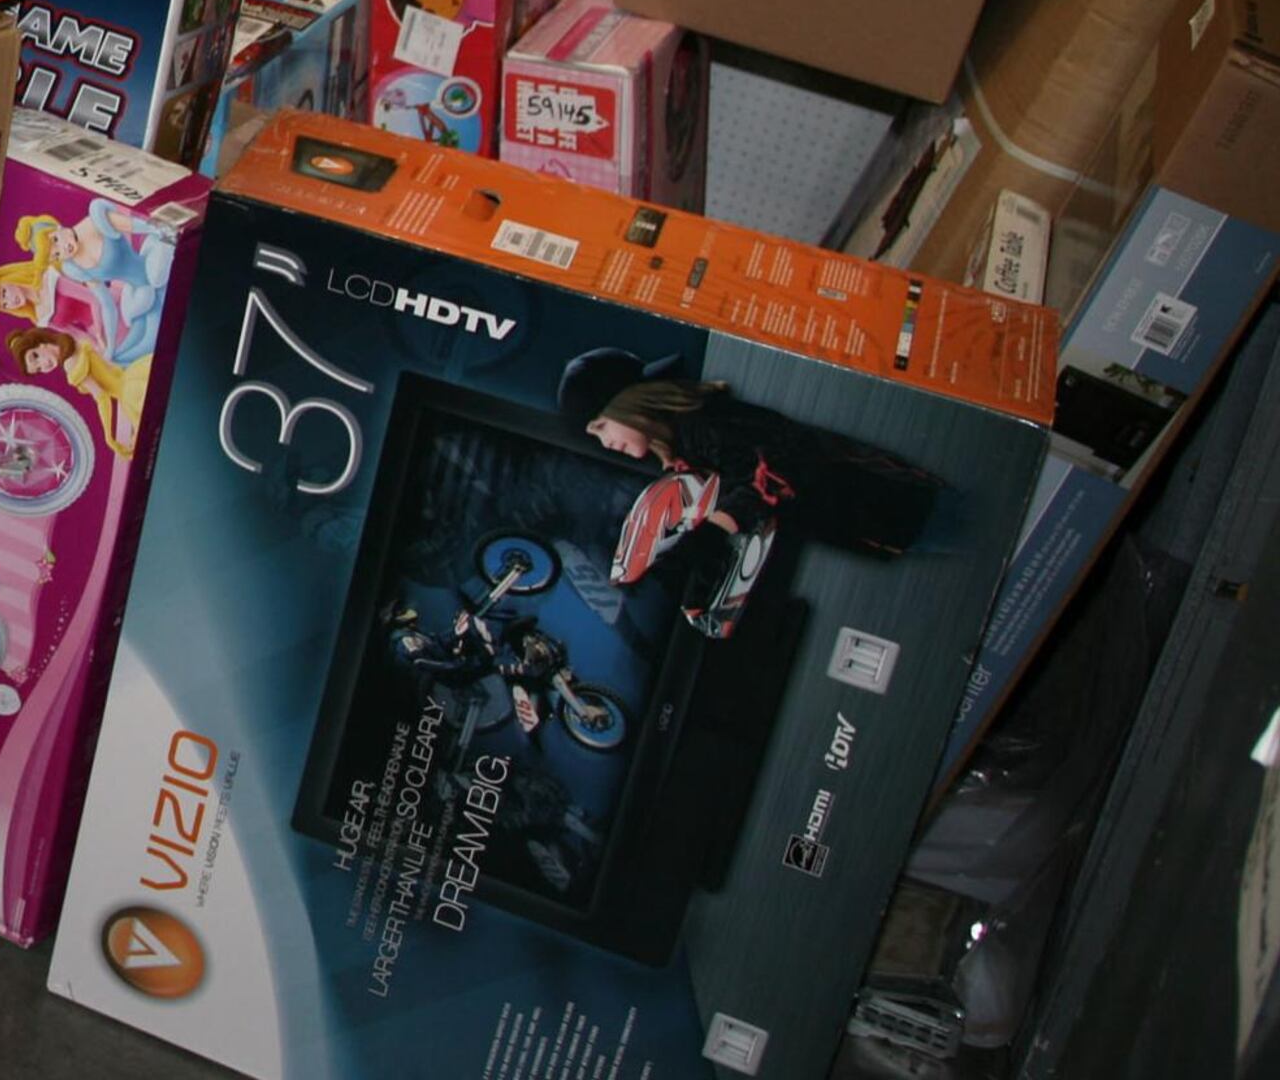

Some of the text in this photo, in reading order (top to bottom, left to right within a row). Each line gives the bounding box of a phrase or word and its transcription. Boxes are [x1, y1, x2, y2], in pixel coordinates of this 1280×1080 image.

[16, 2, 136, 77] AME
[526, 93, 593, 126] 59145
[404, 694, 447, 789] CLEARLY.
[139, 728, 219, 892] VIZIO
[395, 785, 422, 822] SO
[803, 786, 833, 842] HDMI
[333, 809, 368, 871] HUGE
[404, 820, 434, 872] LIFE
[431, 809, 494, 933] DREAM
[465, 753, 513, 816] BIG.
[389, 865, 423, 920] THAN
[367, 914, 408, 999] LARGER
